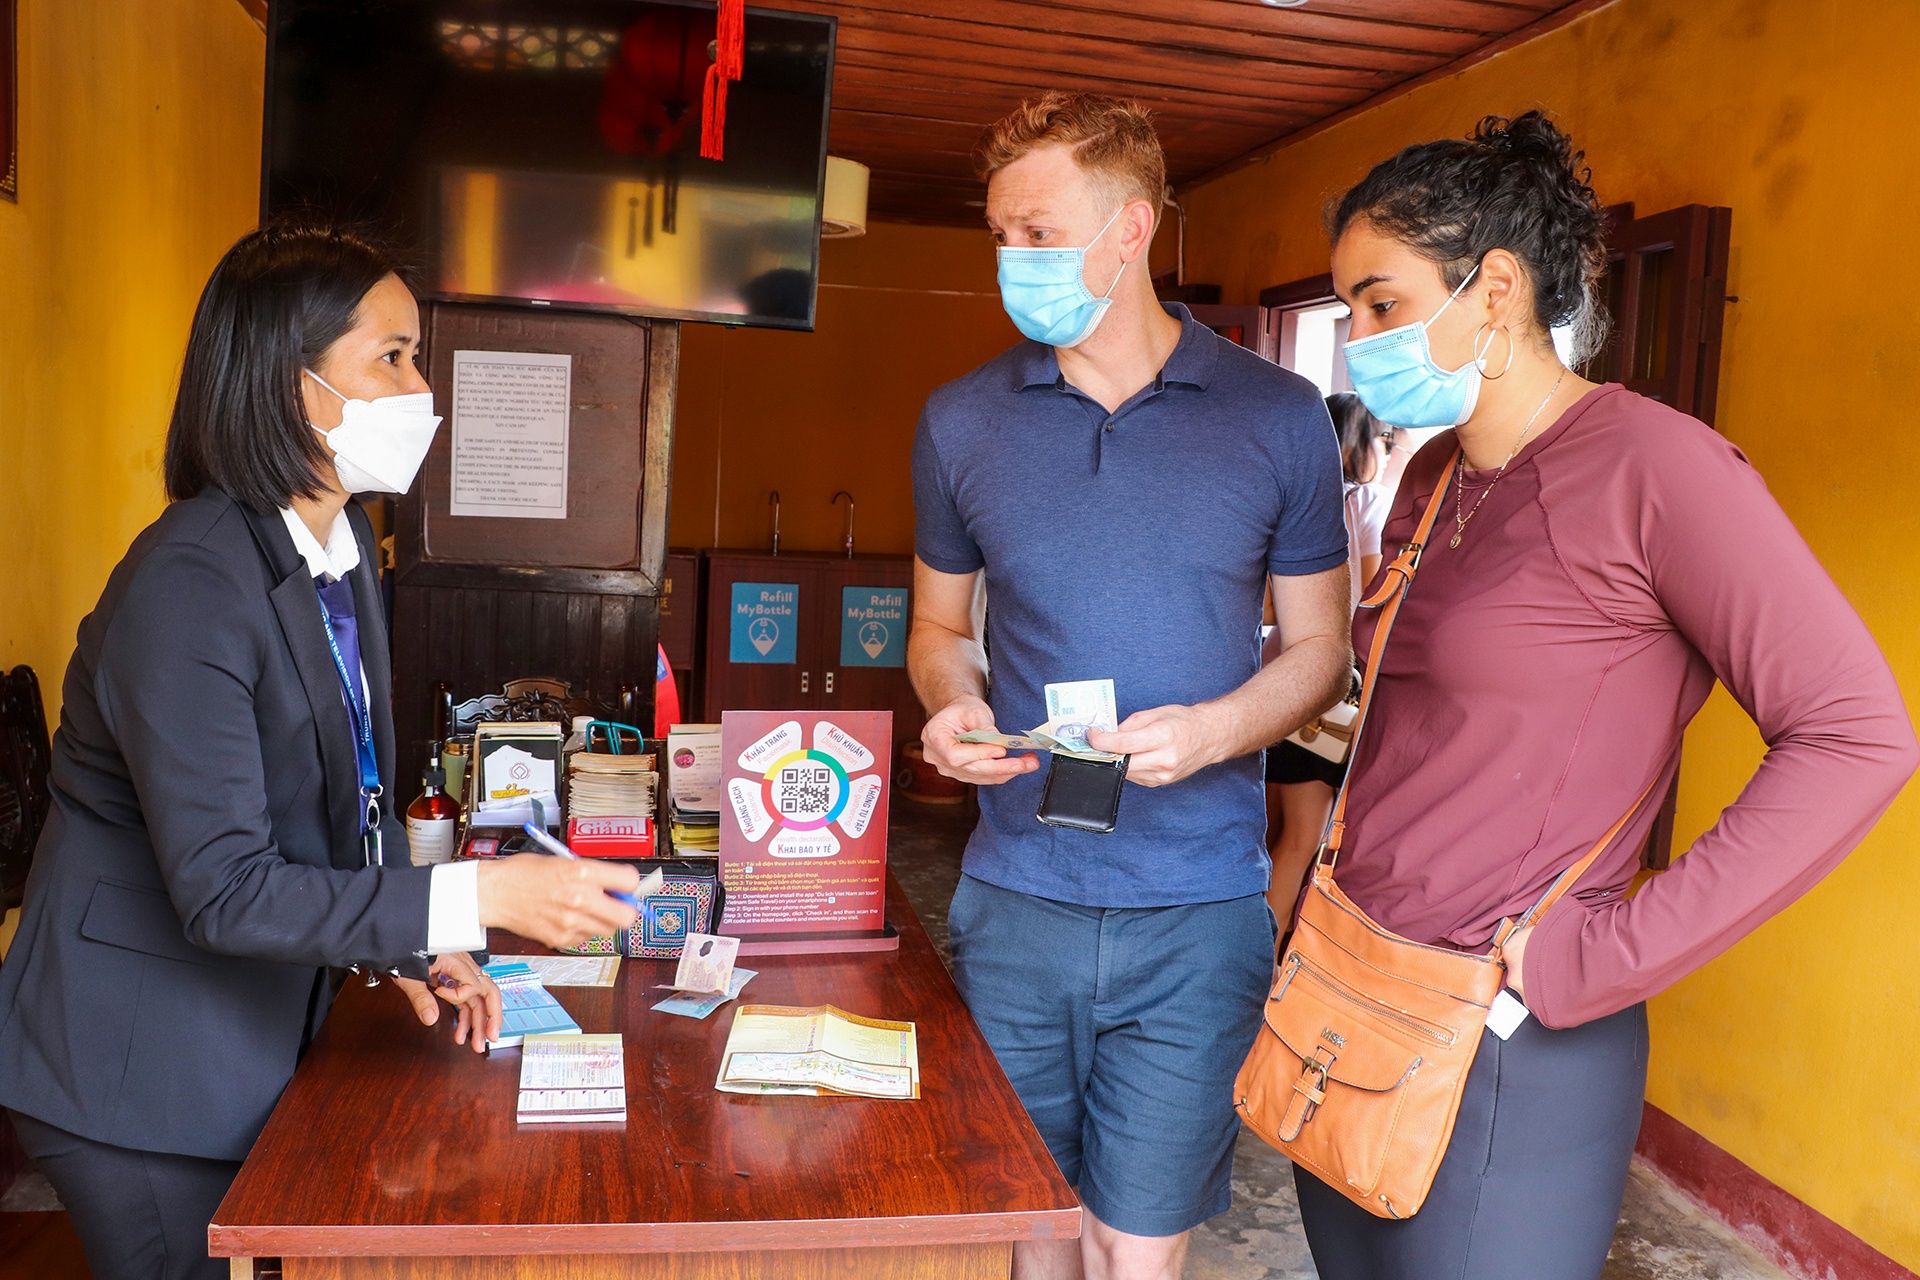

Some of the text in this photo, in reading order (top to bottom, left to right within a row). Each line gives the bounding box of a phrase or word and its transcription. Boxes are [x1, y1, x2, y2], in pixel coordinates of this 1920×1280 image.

[761, 592, 792, 602] Refill
[871, 596, 902, 606] Refill
[737, 604, 792, 617] MyBottle
[848, 608, 901, 620] MyBottle
[331, 640, 352, 688] TELEVISION
[757, 739, 792, 765] Facemask
[822, 737, 857, 765] Disinfection
[747, 791, 762, 822] Distance
[845, 790, 864, 827] gathering
[578, 821, 634, 835] Giảm
[1321, 1027, 1347, 1049] MSK
